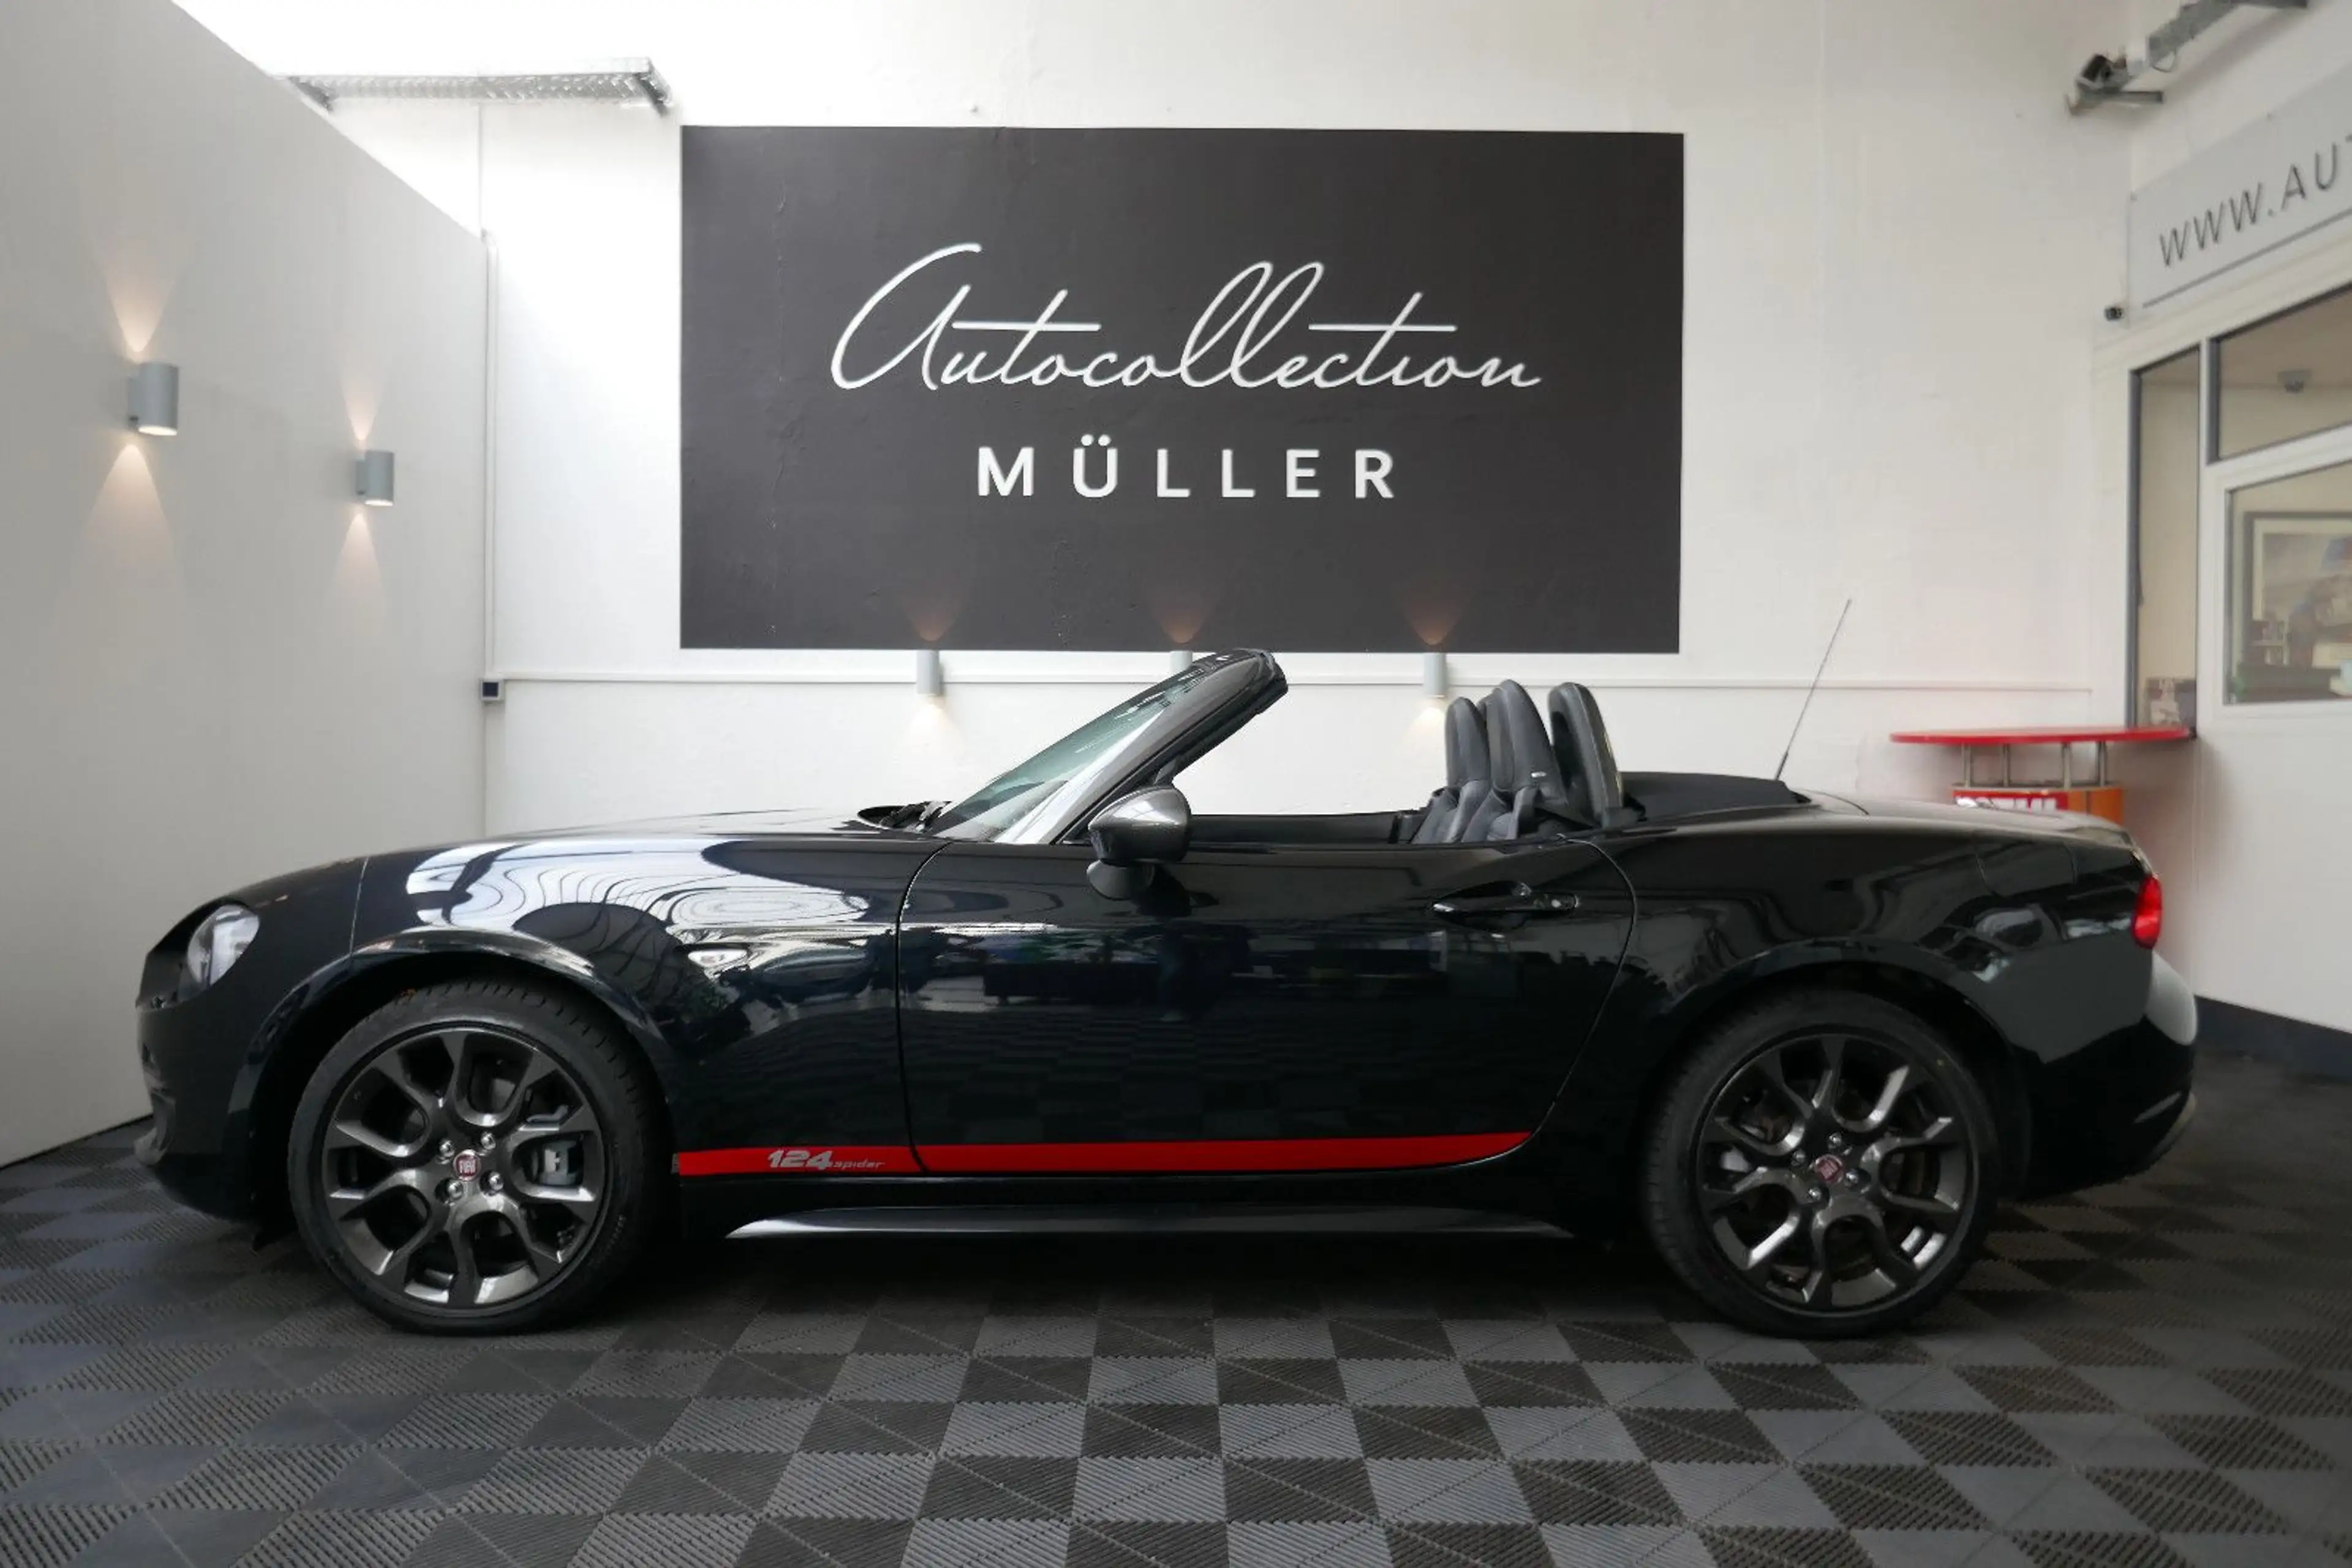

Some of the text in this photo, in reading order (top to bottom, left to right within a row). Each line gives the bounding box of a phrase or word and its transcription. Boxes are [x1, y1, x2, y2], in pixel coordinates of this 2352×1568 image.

[2158, 132, 2352, 268] WWW.AU
[830, 242, 1540, 391] Autocollection
[978, 434, 1394, 499] MÜLLER
[767, 1149, 886, 1170] 124 spider
